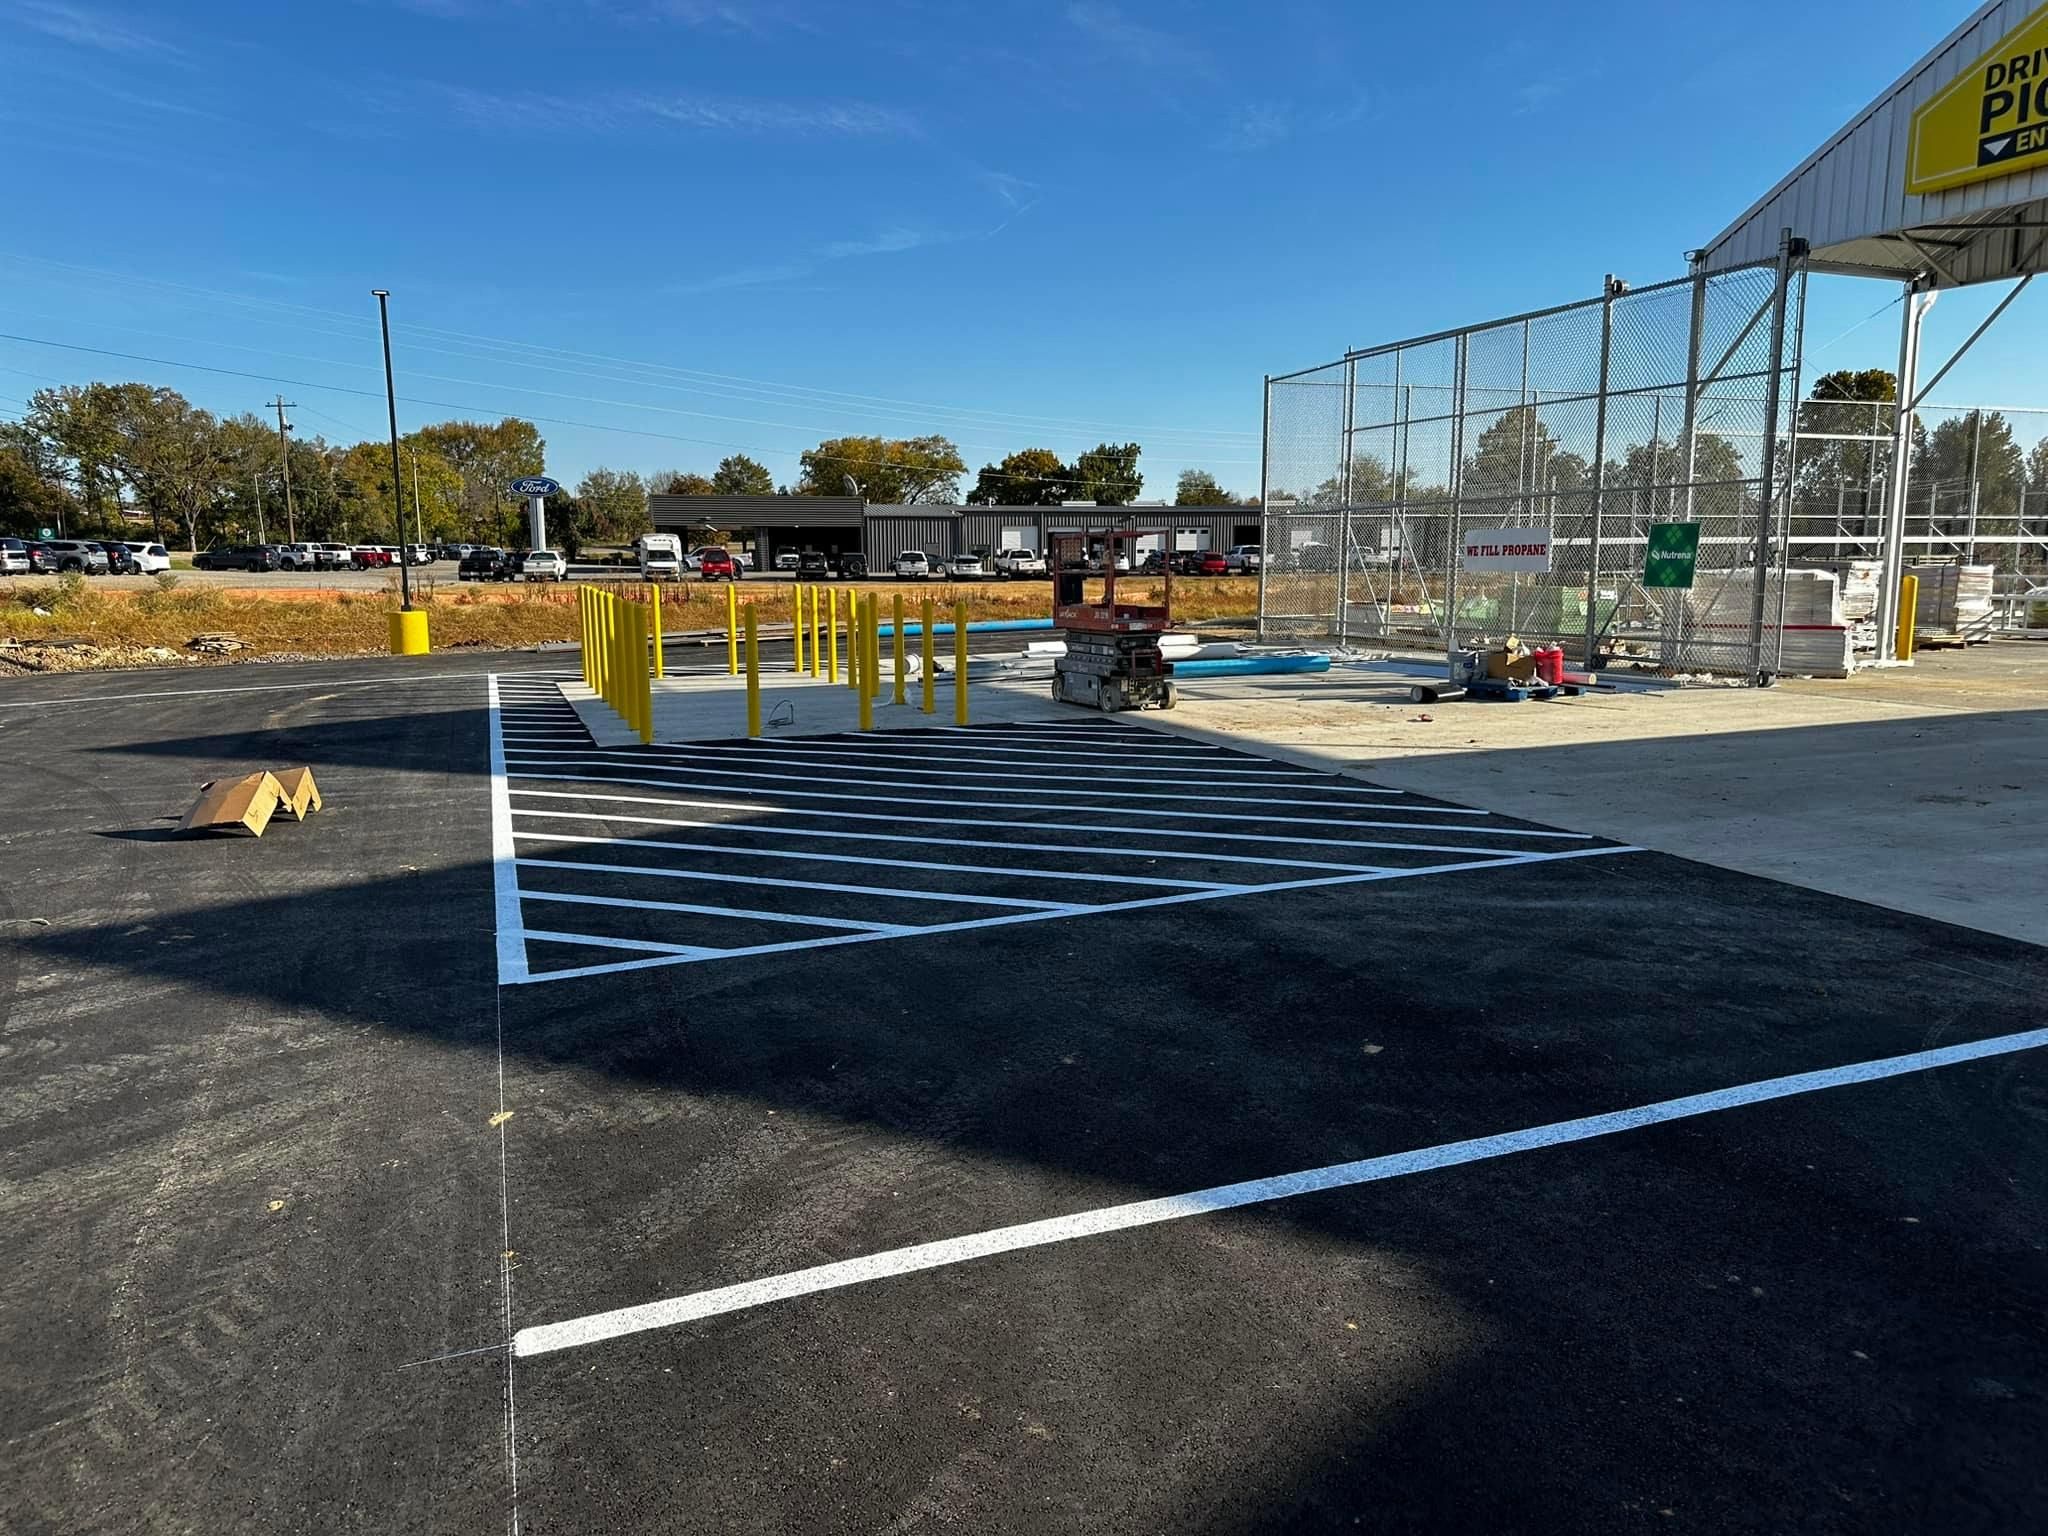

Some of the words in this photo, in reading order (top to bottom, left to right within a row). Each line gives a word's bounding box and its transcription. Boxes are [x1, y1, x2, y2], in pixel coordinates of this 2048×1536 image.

[1985, 48, 2048, 91] DRI
[2015, 126, 2048, 152] EN
[520, 480, 550, 493] Ford
[1466, 545, 1479, 557] WE
[1480, 545, 1500, 557] FILL
[1502, 544, 1547, 556] PROPANE
[1661, 550, 1691, 560] Nutrena
